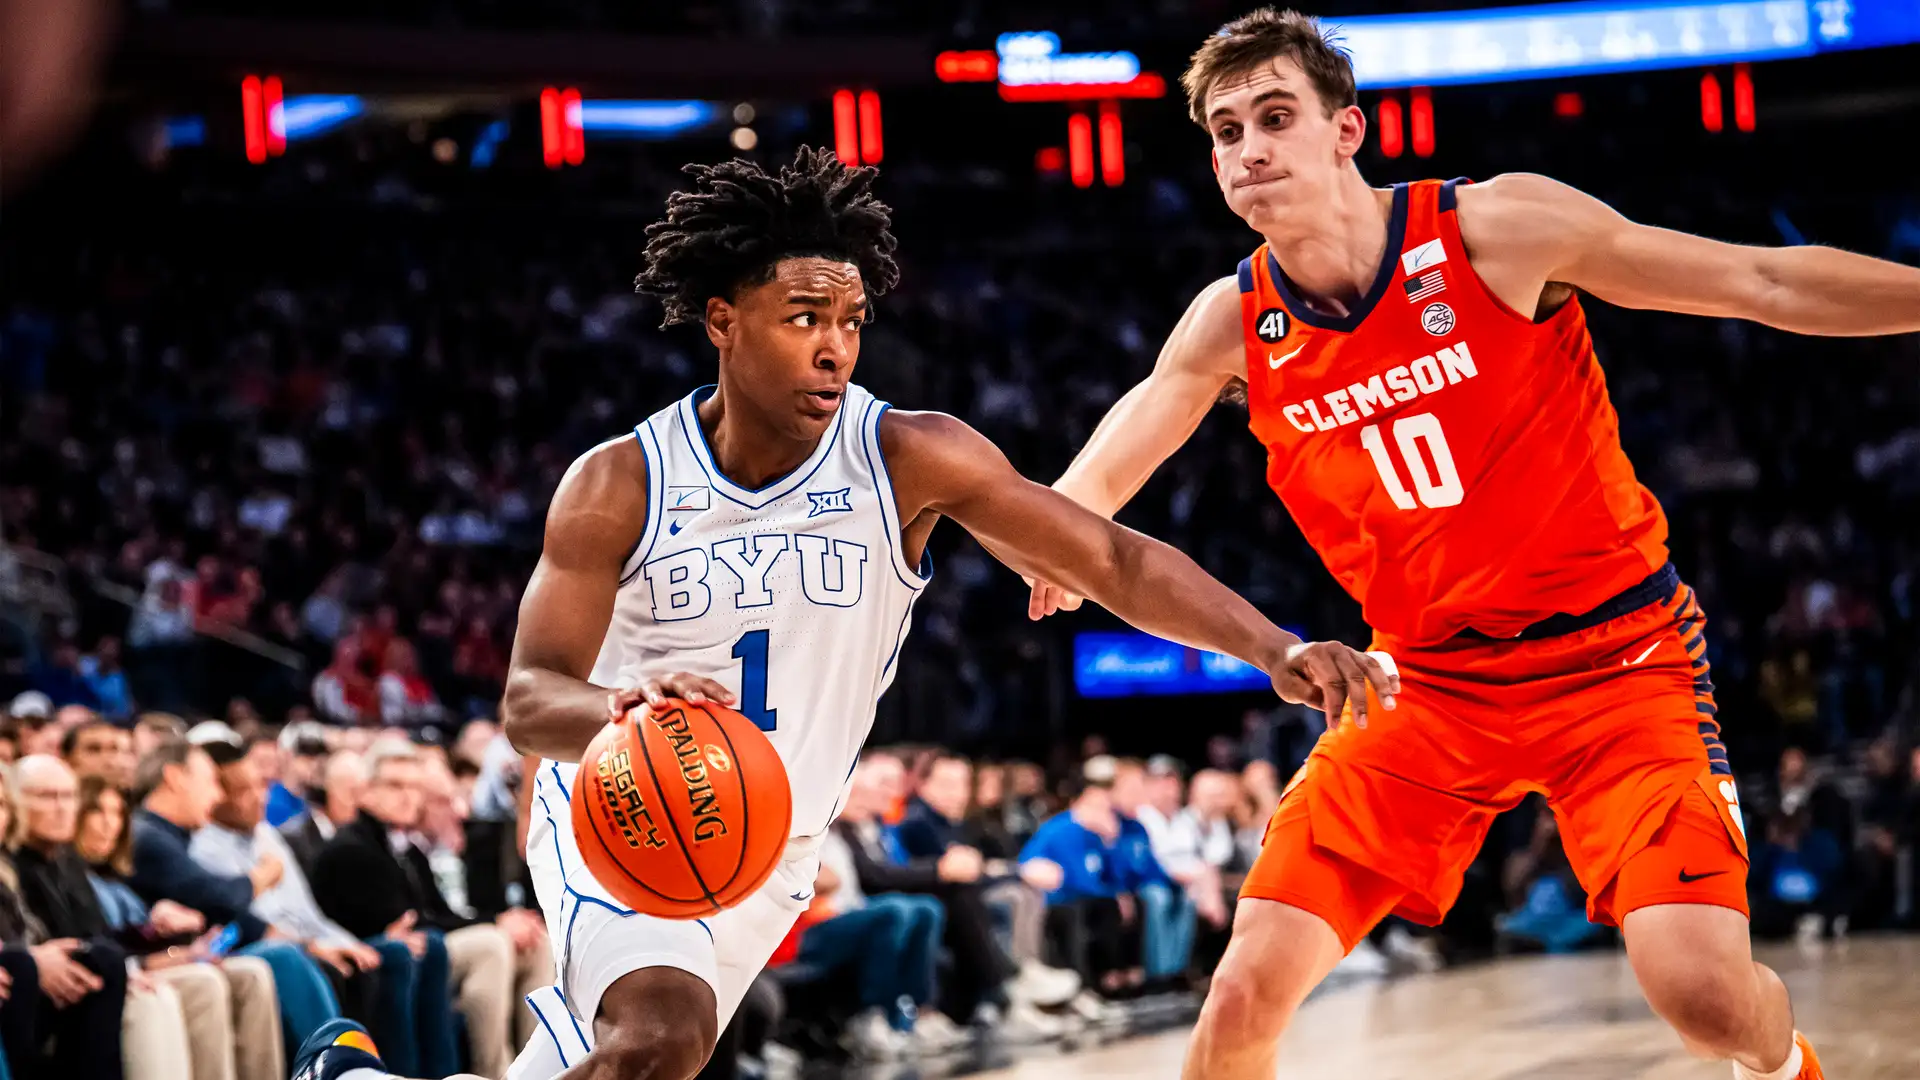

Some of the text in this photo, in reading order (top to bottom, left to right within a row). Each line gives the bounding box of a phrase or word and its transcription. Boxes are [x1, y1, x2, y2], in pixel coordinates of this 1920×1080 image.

[1258, 311, 1284, 338] 41
[1427, 309, 1451, 325] ACC
[1282, 341, 1478, 432] CLEMSON
[1360, 412, 1465, 510] 10
[644, 534, 868, 622] BYU
[731, 628, 777, 732] 1
[649, 707, 728, 843] SPALDING
